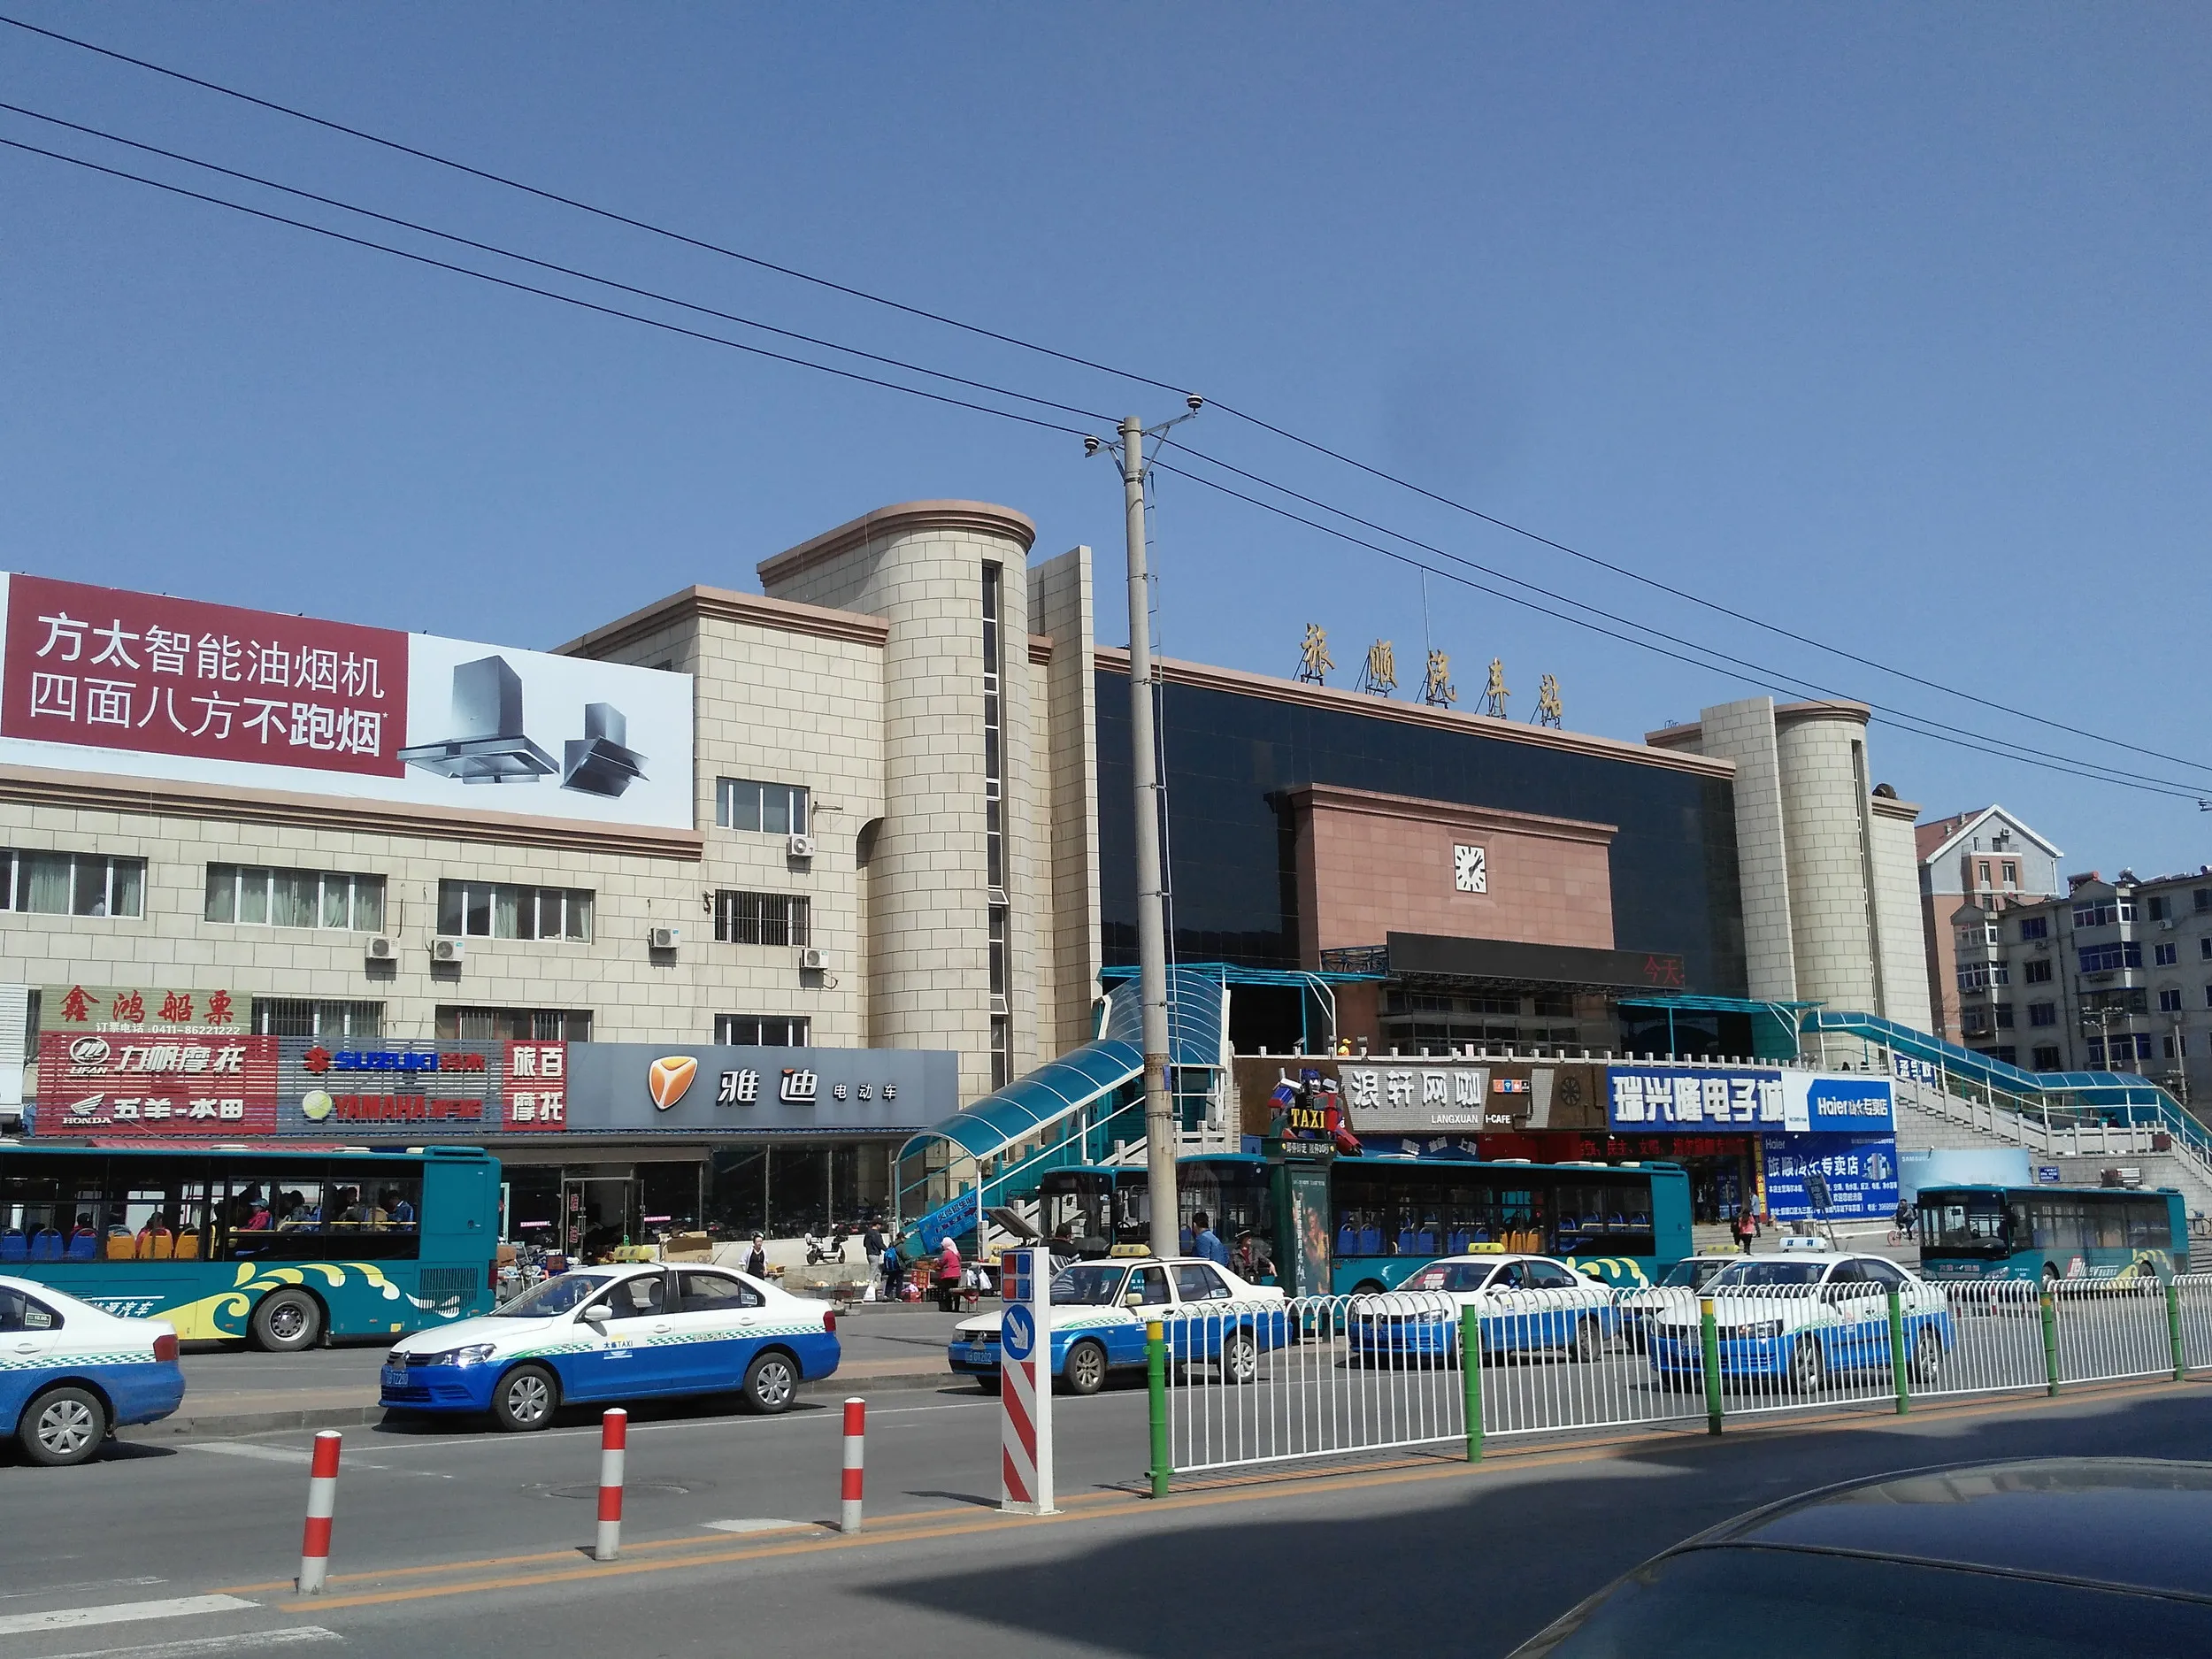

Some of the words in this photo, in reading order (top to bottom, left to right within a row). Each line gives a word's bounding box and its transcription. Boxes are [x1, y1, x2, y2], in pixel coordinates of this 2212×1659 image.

[36, 611, 385, 700] 方太智能油烟机
[29, 672, 381, 758] 四面八方不跑烟
[60, 985, 234, 1026] 鑫鸿船票
[113, 1045, 246, 1073] 力帆摩托
[334, 1050, 439, 1071] SUZUKI
[513, 1046, 564, 1077] 旅百
[717, 1068, 818, 1102] 雅迪
[833, 1083, 897, 1101] 电动车
[1351, 1070, 1482, 1107] 浪轩网咖
[334, 1094, 426, 1118] YAMAHA
[512, 1092, 564, 1121] 摩托
[1291, 1108, 1325, 1129] TAXI
[1431, 1114, 1479, 1124] LANGXUAN
[1817, 1096, 1847, 1115] Haier
[1765, 1138, 1786, 1150] Haier
[1768, 1154, 1859, 1178] 旅顺海尔专卖店
